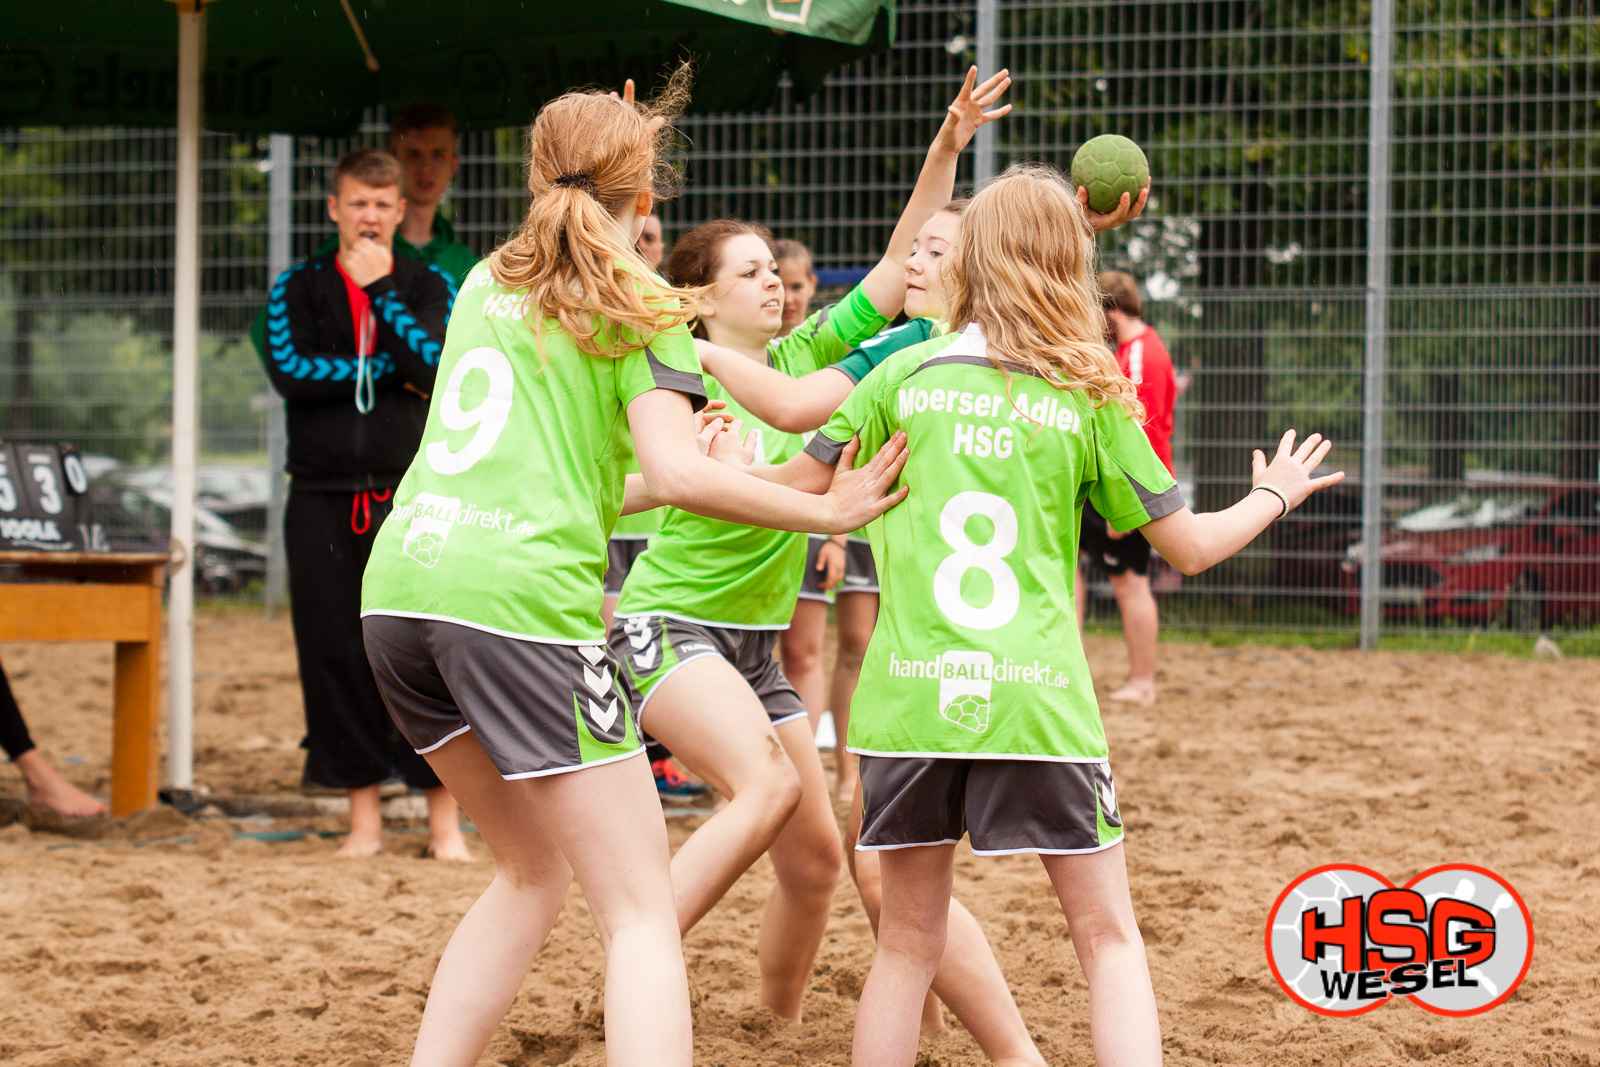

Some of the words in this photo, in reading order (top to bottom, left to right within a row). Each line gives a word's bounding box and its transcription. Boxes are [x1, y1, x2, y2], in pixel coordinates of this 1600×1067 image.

[482, 292, 531, 321] HSG
[425, 346, 515, 476] 9
[898, 386, 1004, 420] Moerser
[953, 423, 1014, 459] HSG
[33, 465, 63, 514] 3
[933, 490, 1020, 631] 8
